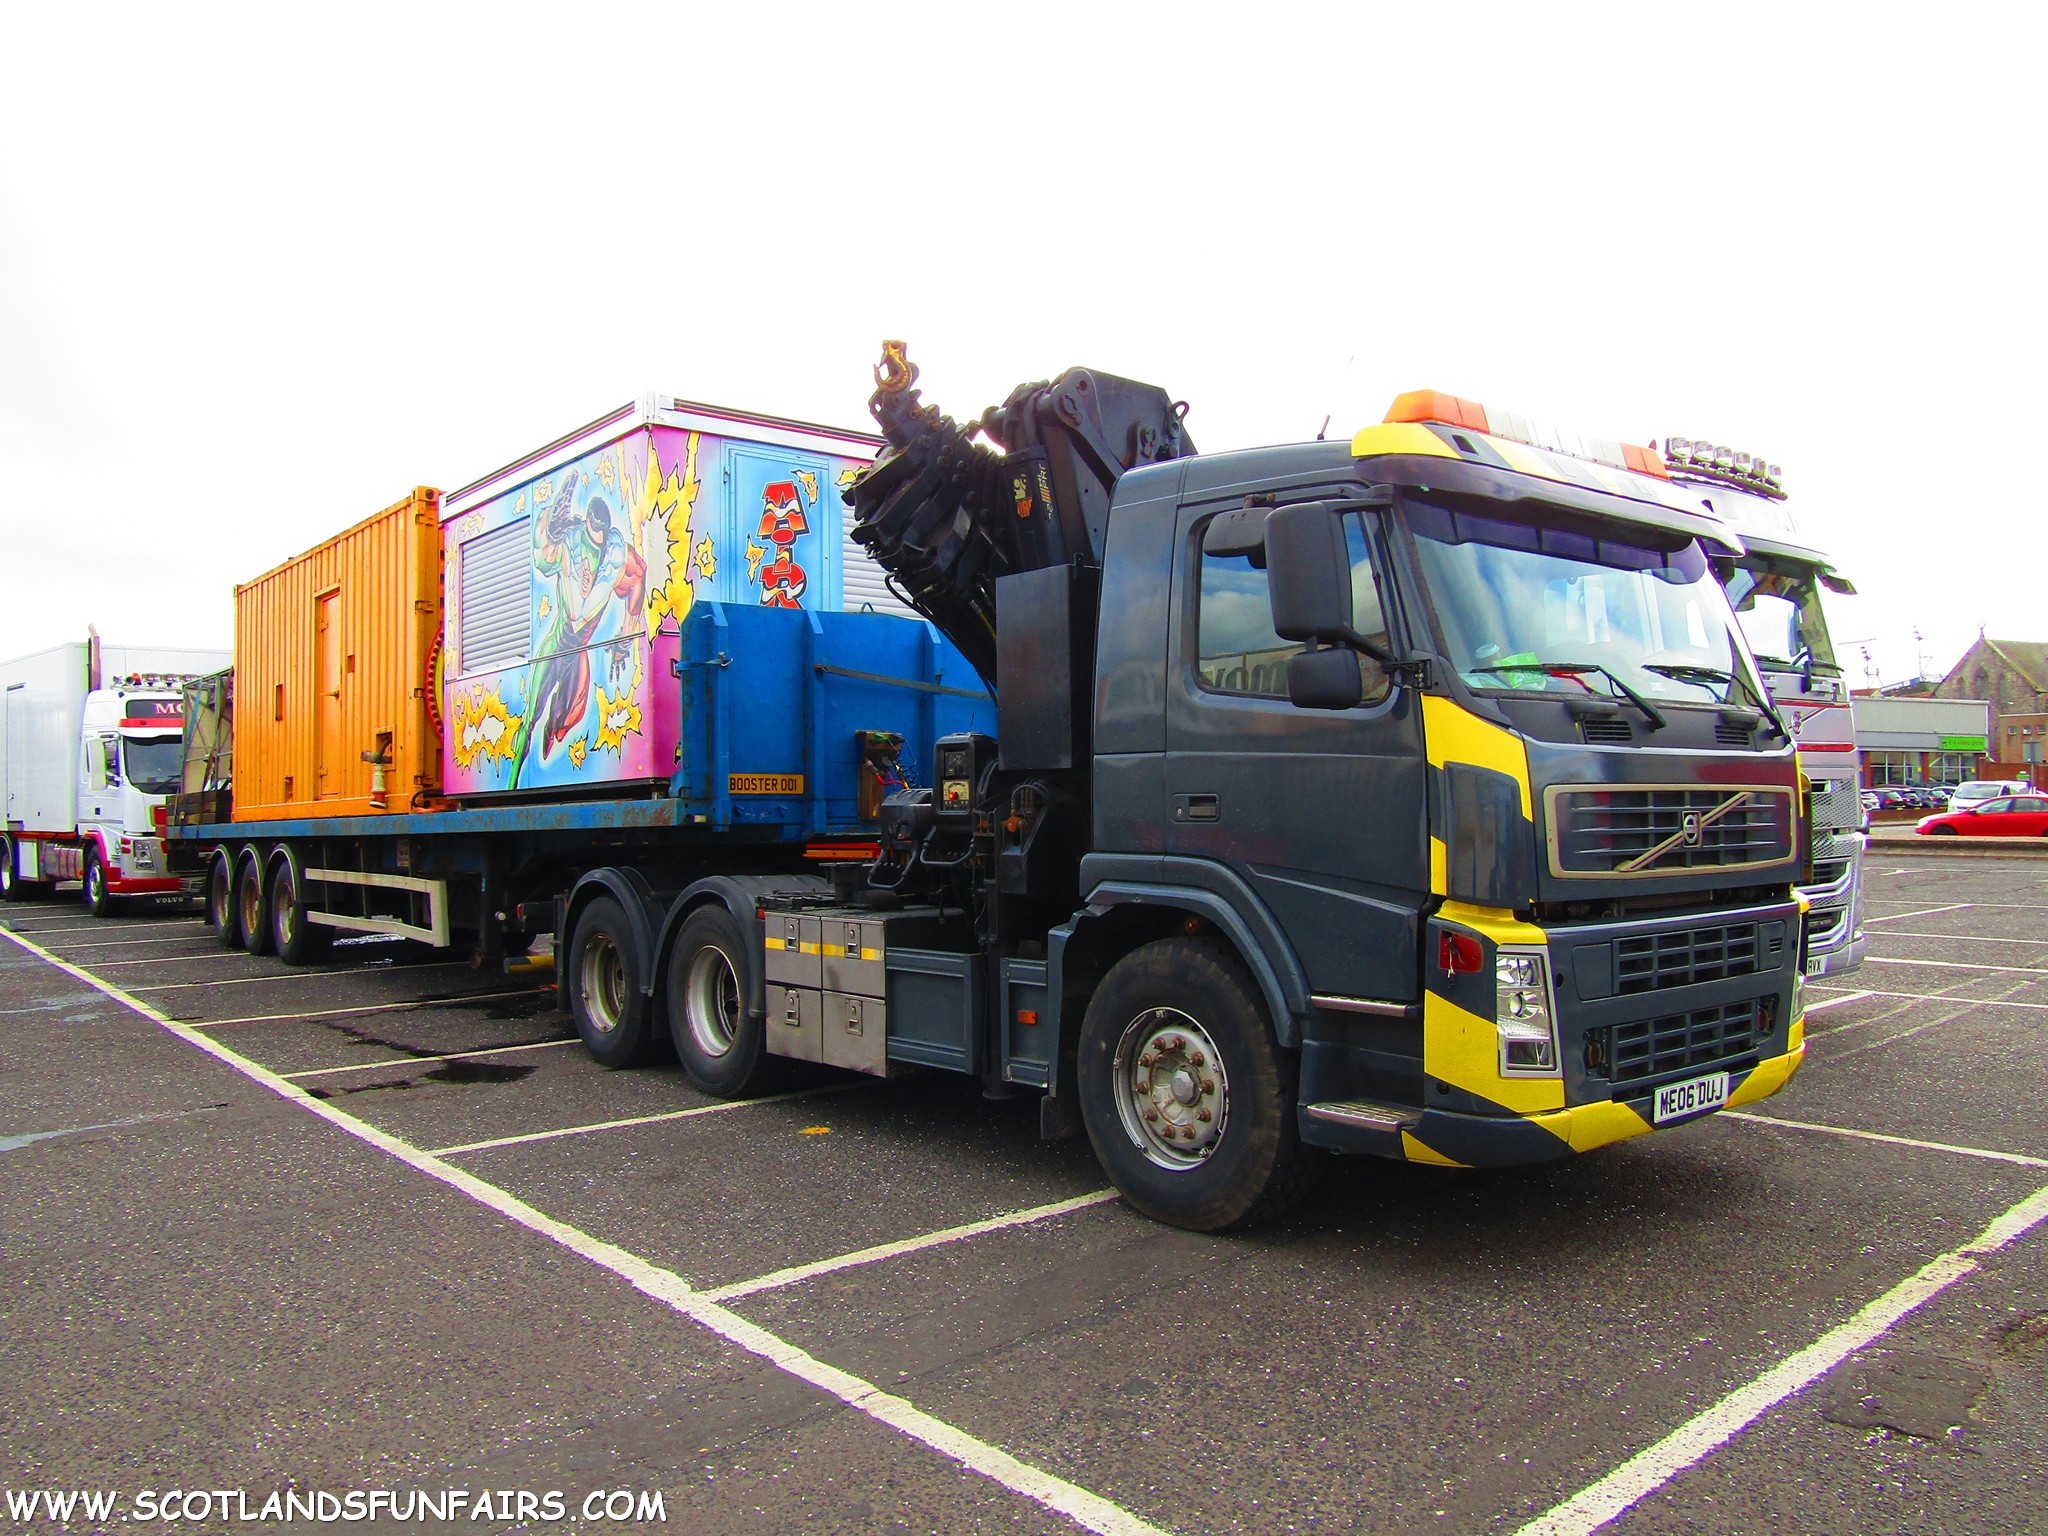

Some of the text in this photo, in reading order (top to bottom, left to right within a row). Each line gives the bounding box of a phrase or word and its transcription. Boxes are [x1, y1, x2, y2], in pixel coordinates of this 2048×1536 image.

[729, 777, 778, 791] BOOSTER
[155, 896, 184, 904] VOLVO
[1660, 1077, 1724, 1117] ME06 DUJ
